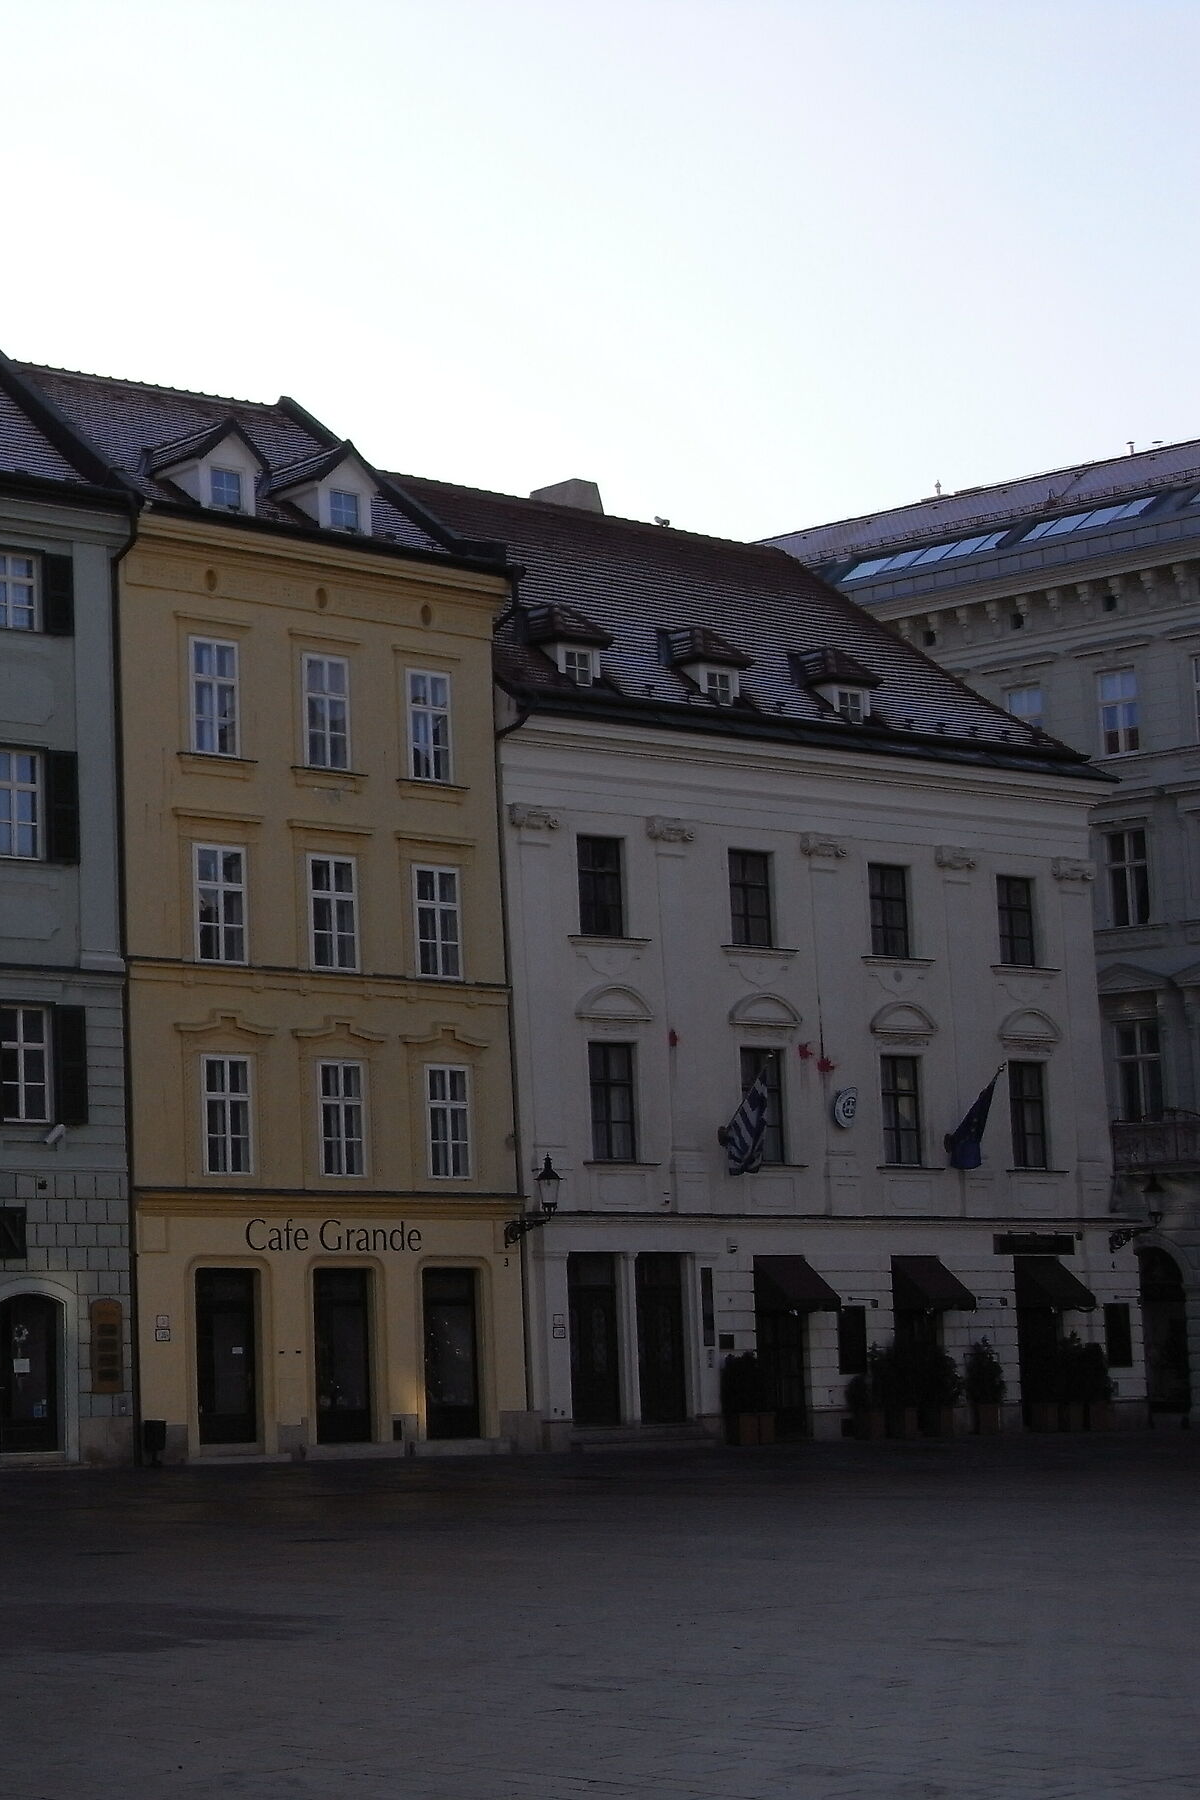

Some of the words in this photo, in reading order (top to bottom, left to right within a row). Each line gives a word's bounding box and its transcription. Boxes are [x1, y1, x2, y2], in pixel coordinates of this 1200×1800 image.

[245, 1218, 310, 1252] Cafe
[318, 1219, 423, 1252] Grande
[503, 1257, 509, 1267] 3
